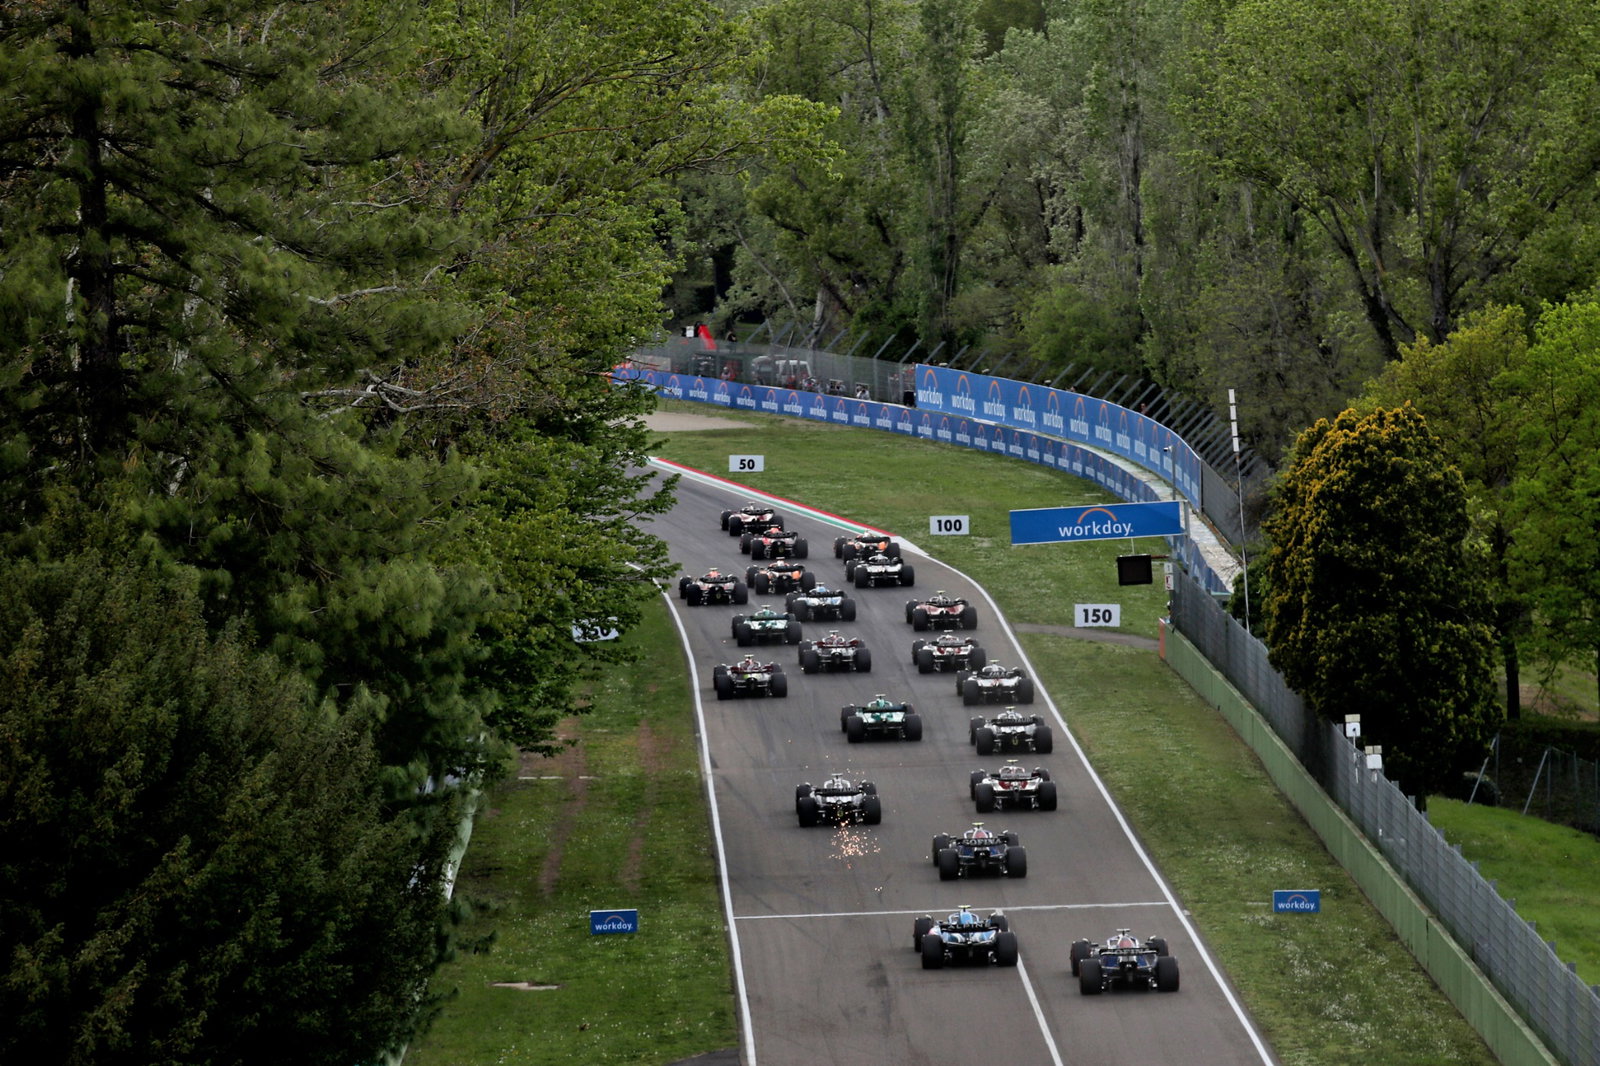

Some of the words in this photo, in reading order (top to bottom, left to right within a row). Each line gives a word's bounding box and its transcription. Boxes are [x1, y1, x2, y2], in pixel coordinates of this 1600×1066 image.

[918, 386, 942, 408] workday
[952, 392, 975, 416] workday
[984, 398, 1005, 422] workday
[1013, 403, 1035, 428] workday
[1043, 408, 1063, 434] workday
[739, 458, 755, 470] 50
[937, 519, 962, 532] 100
[1058, 520, 1132, 537] workday
[1083, 609, 1112, 623] 150
[963, 838, 1002, 846] SOFINA
[1277, 900, 1316, 910] workday
[595, 922, 632, 931] workday
[948, 921, 990, 929] ALPINE
